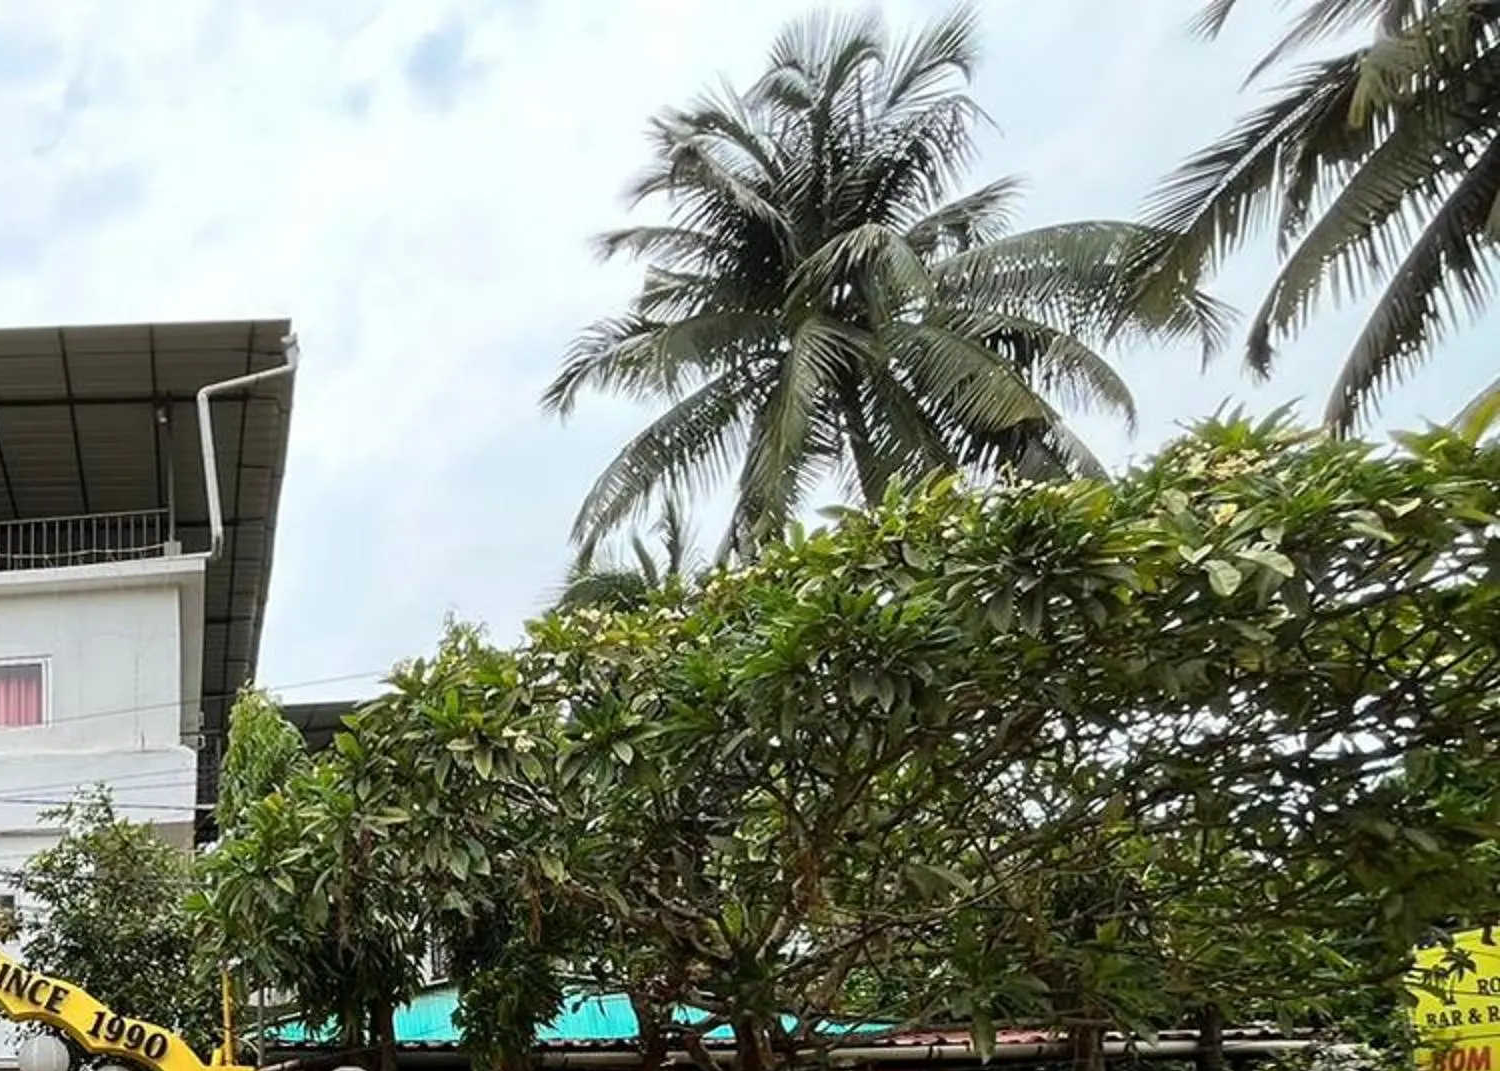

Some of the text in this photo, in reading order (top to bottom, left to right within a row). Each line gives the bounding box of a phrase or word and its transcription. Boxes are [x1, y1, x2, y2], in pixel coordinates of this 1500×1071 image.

[87, 1010, 169, 1060] 1990
[1426, 1009, 1463, 1028] BAR
[1468, 1007, 1482, 1025] &
